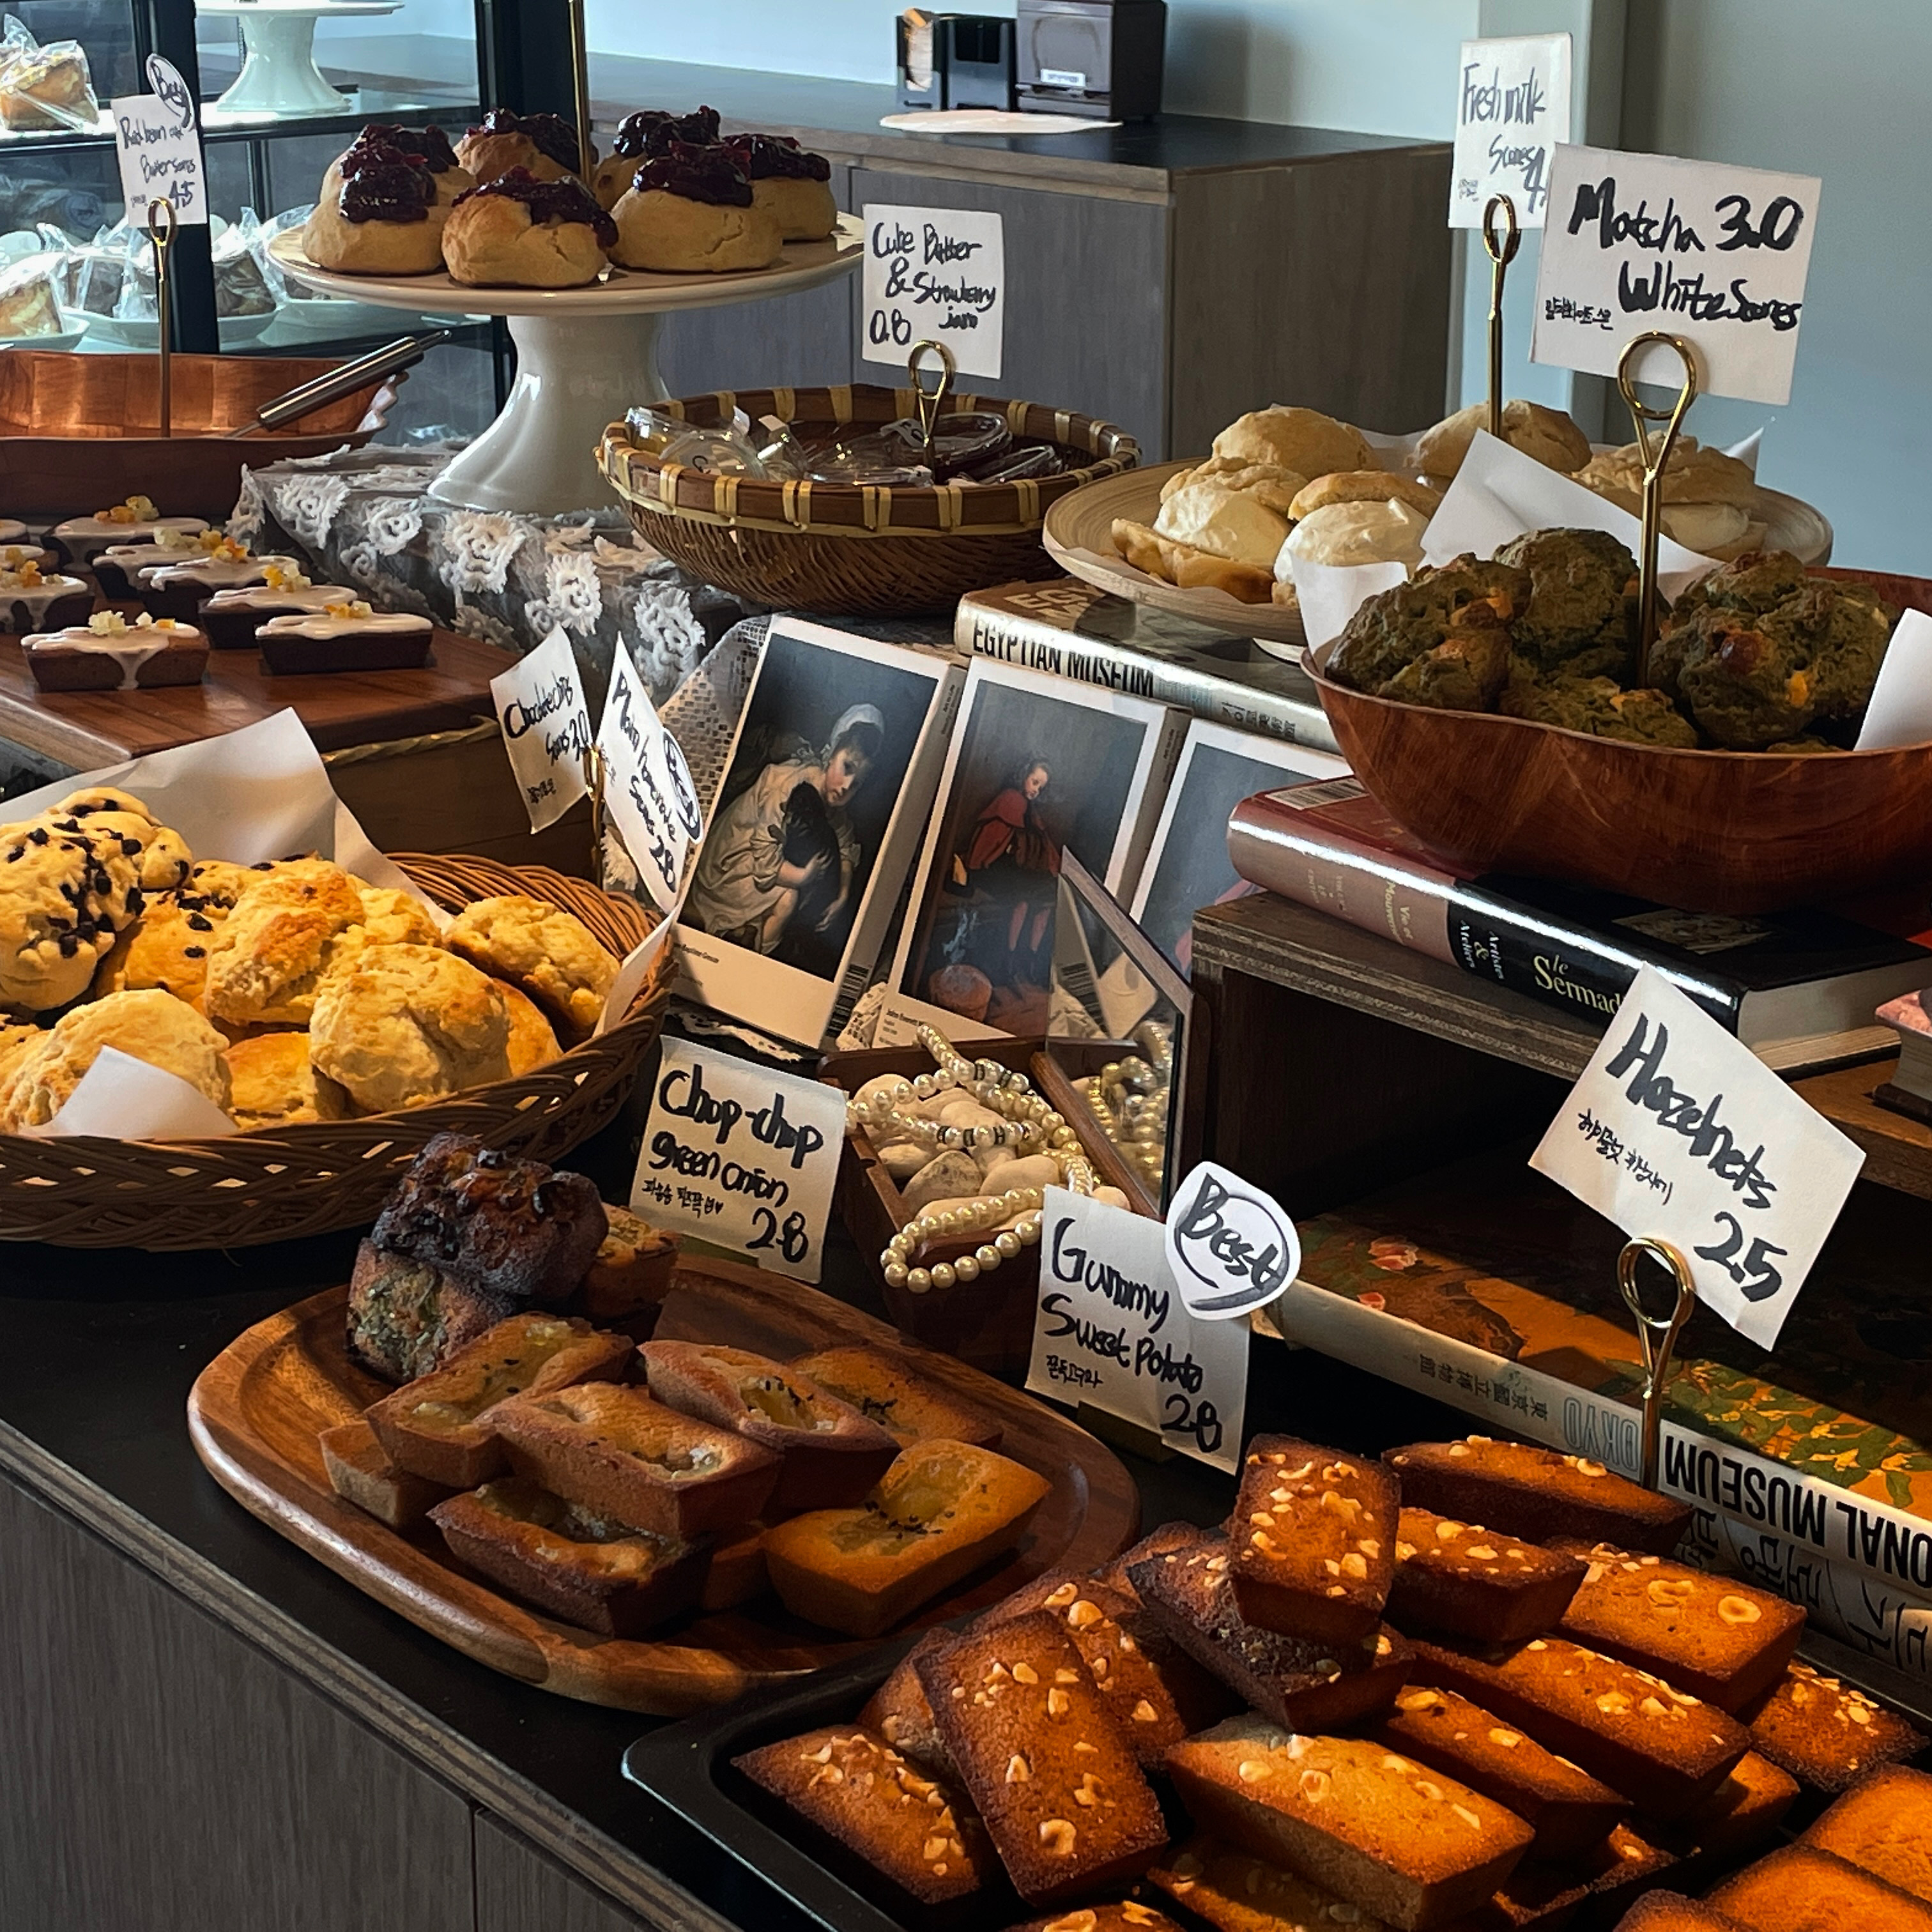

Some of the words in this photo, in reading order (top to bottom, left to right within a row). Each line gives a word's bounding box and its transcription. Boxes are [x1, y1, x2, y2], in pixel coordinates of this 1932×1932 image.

[872, 222, 916, 258] Cube
[923, 223, 983, 265] Butter
[1567, 177, 1705, 252] Matcha
[885, 256, 915, 298] &
[973, 617, 1061, 675] EGYPTIAN
[1067, 650, 1154, 699] MUSEUM
[1474, 941, 1489, 960] &
[1533, 955, 1621, 1015] Sermad
[659, 1064, 824, 1169] Chop-chop
[1605, 1013, 1778, 1209] Hazelnuts
[648, 1131, 721, 1180] green
[721, 1162, 789, 1208] onion
[1176, 1172, 1279, 1291] Best
[1053, 1218, 1170, 1333] Gummy
[1041, 1293, 1131, 1368] Sweet
[1135, 1336, 1203, 1394] Potato
[1563, 1397, 1639, 1470] OKYO
[1664, 1435, 1827, 1549] MUSEUM
[1836, 1501, 1932, 1589] ONAL
